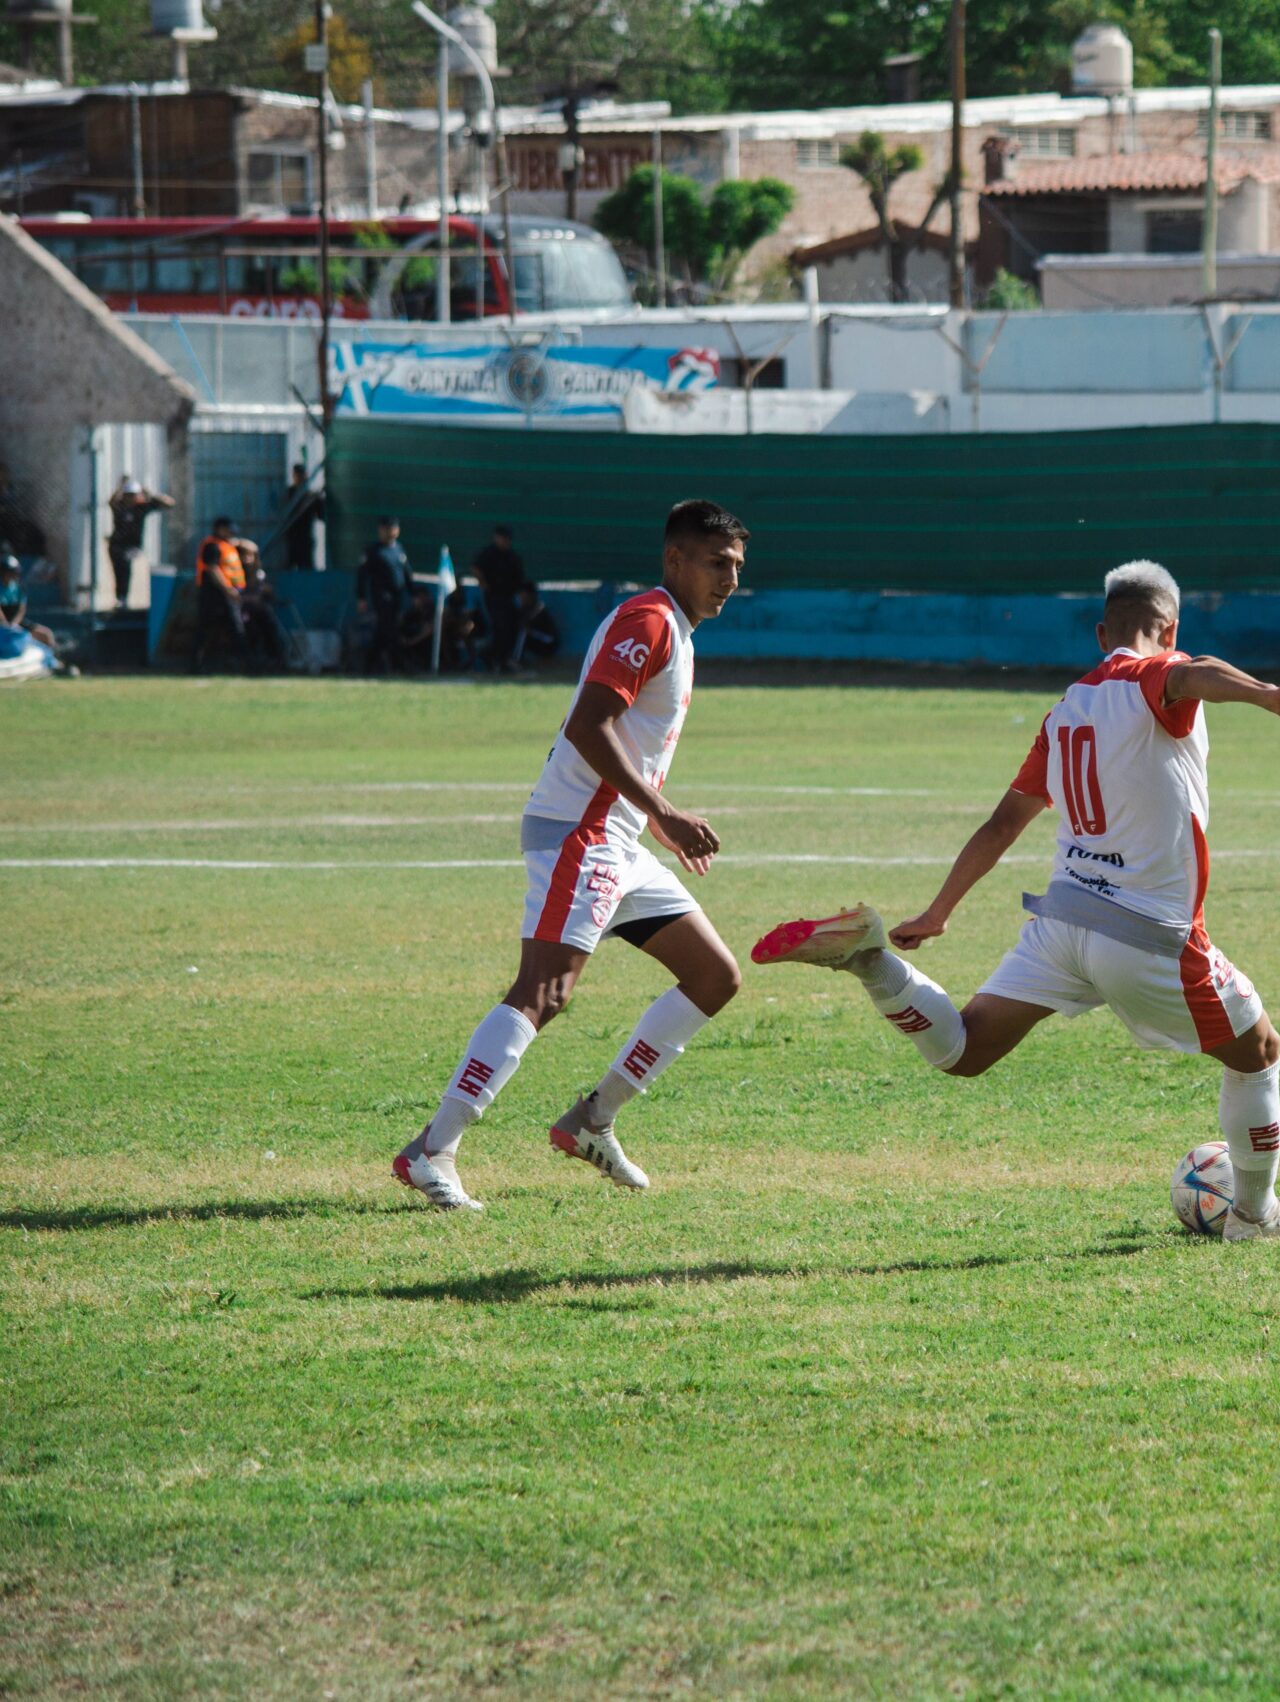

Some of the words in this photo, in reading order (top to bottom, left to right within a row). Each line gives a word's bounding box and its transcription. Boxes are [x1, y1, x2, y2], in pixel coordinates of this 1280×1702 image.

[405, 367, 498, 395] CANTINA
[556, 367, 648, 396] CANTINA
[613, 637, 650, 669] 4G
[1057, 725, 1107, 836] 10
[457, 1057, 495, 1098] HLH
[623, 1039, 661, 1080] HLH
